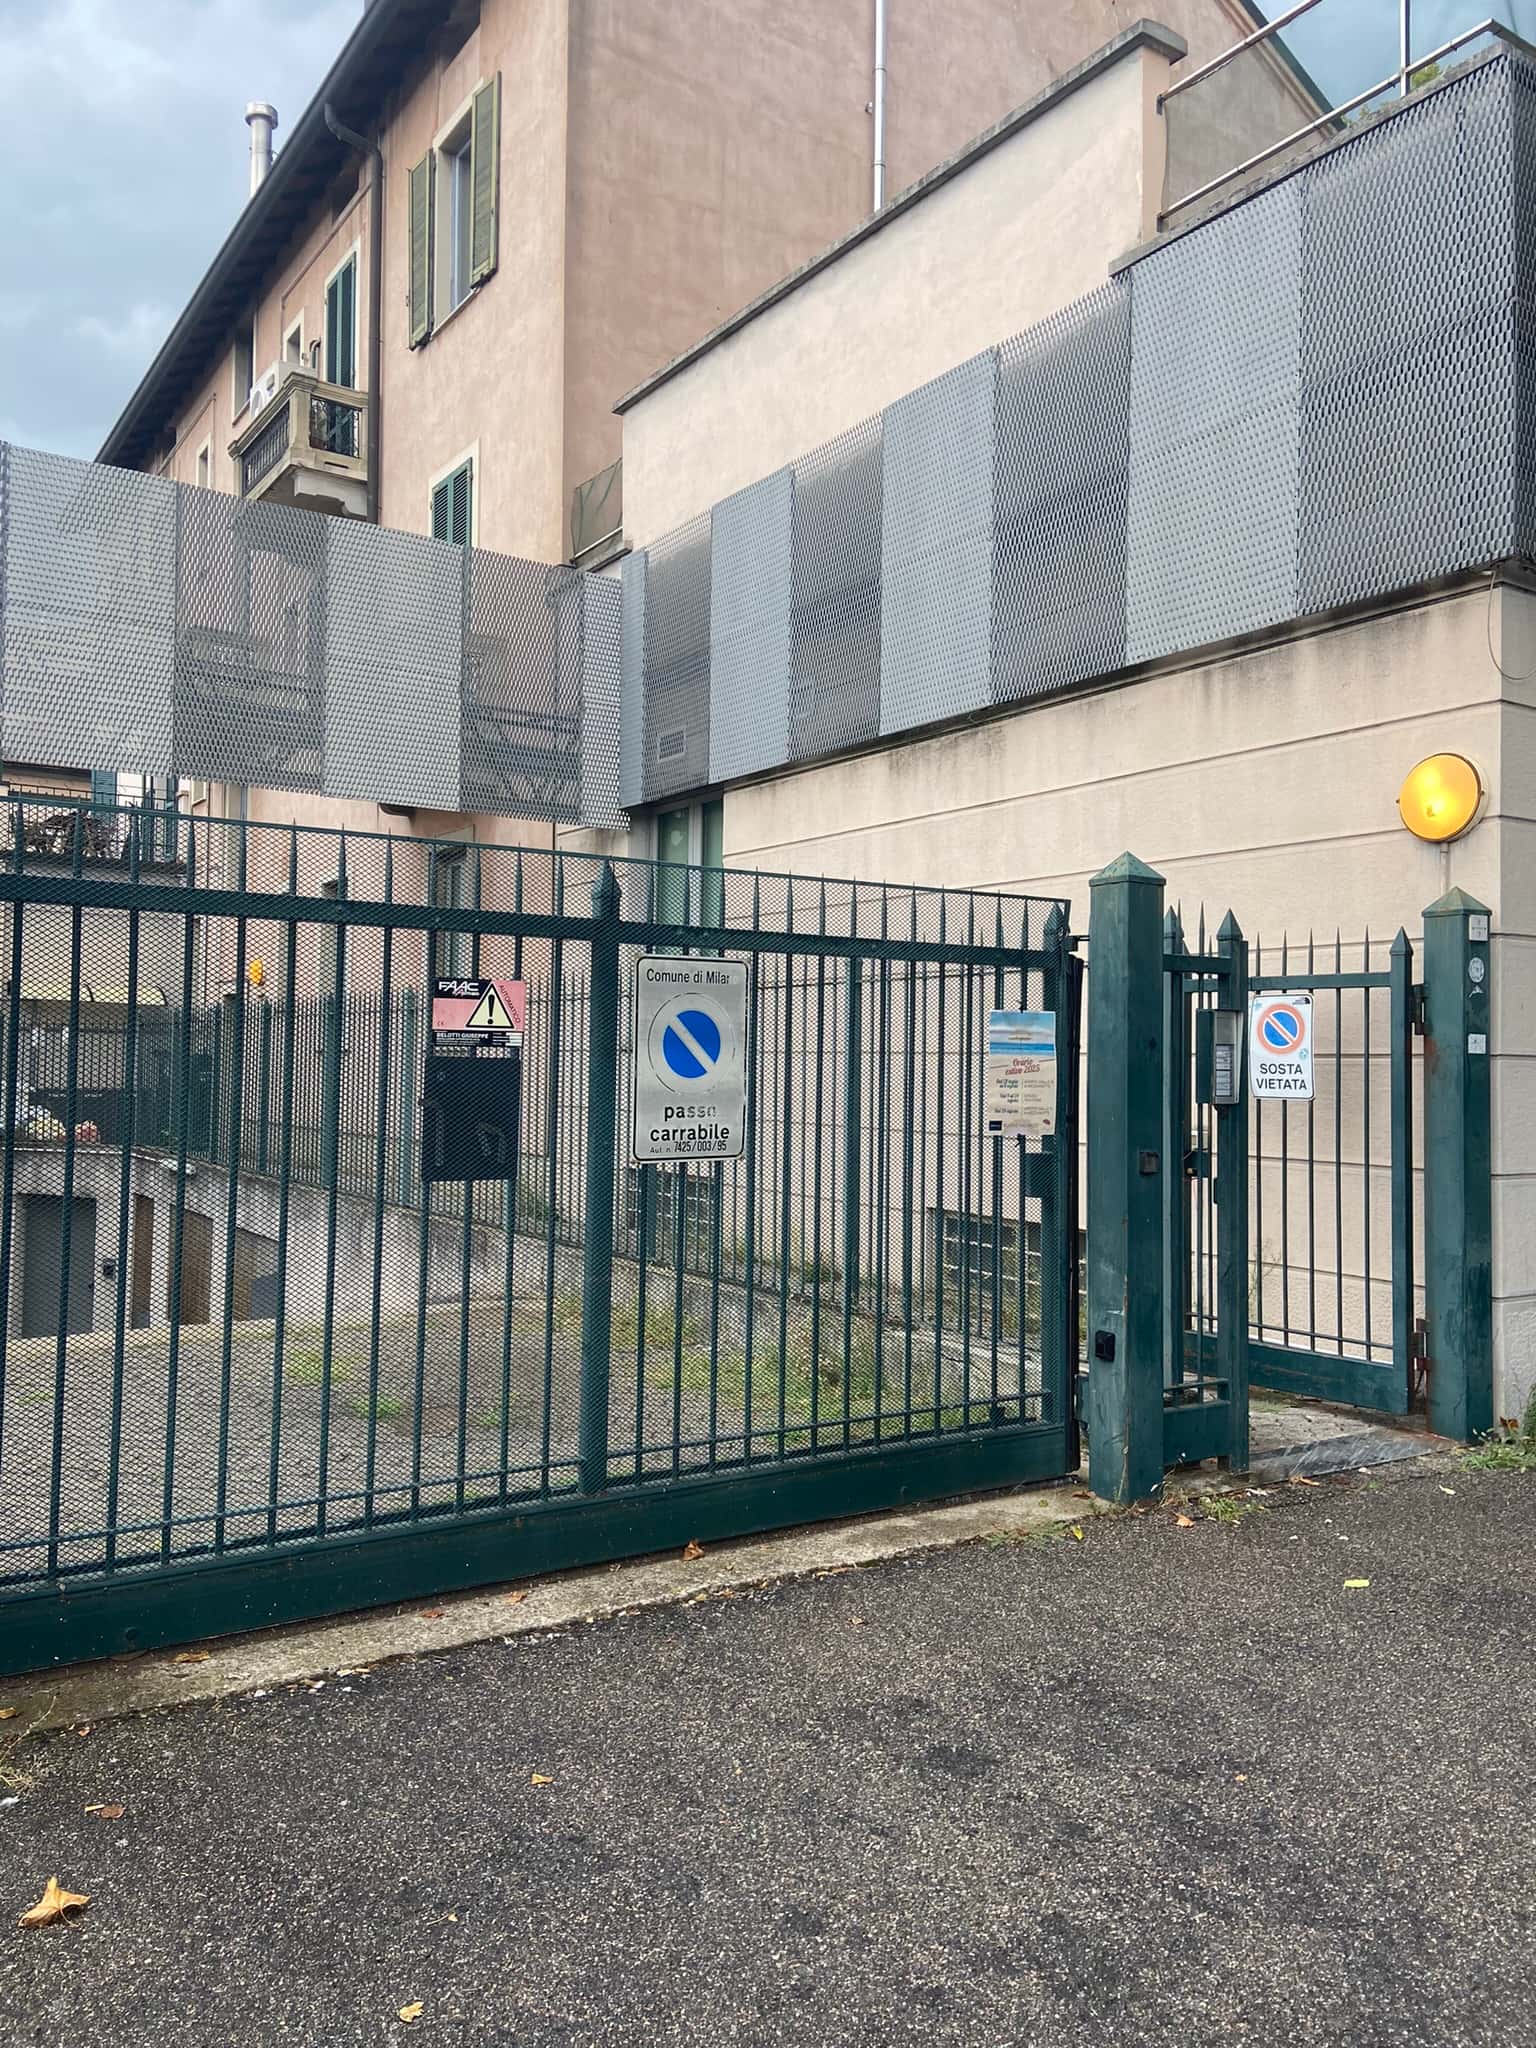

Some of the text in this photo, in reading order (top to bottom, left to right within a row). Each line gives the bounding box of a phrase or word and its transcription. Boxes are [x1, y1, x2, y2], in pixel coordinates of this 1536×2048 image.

[646, 968, 738, 985] Comune di Mila
[438, 981, 479, 993] FAAC
[499, 985, 521, 1024] AUTOMATICO
[1259, 1063, 1303, 1075] SOSTA
[1256, 1078, 1307, 1090] VIETATA
[650, 1123, 730, 1142] carrabile
[674, 1140, 727, 1153] 7425/003/95
